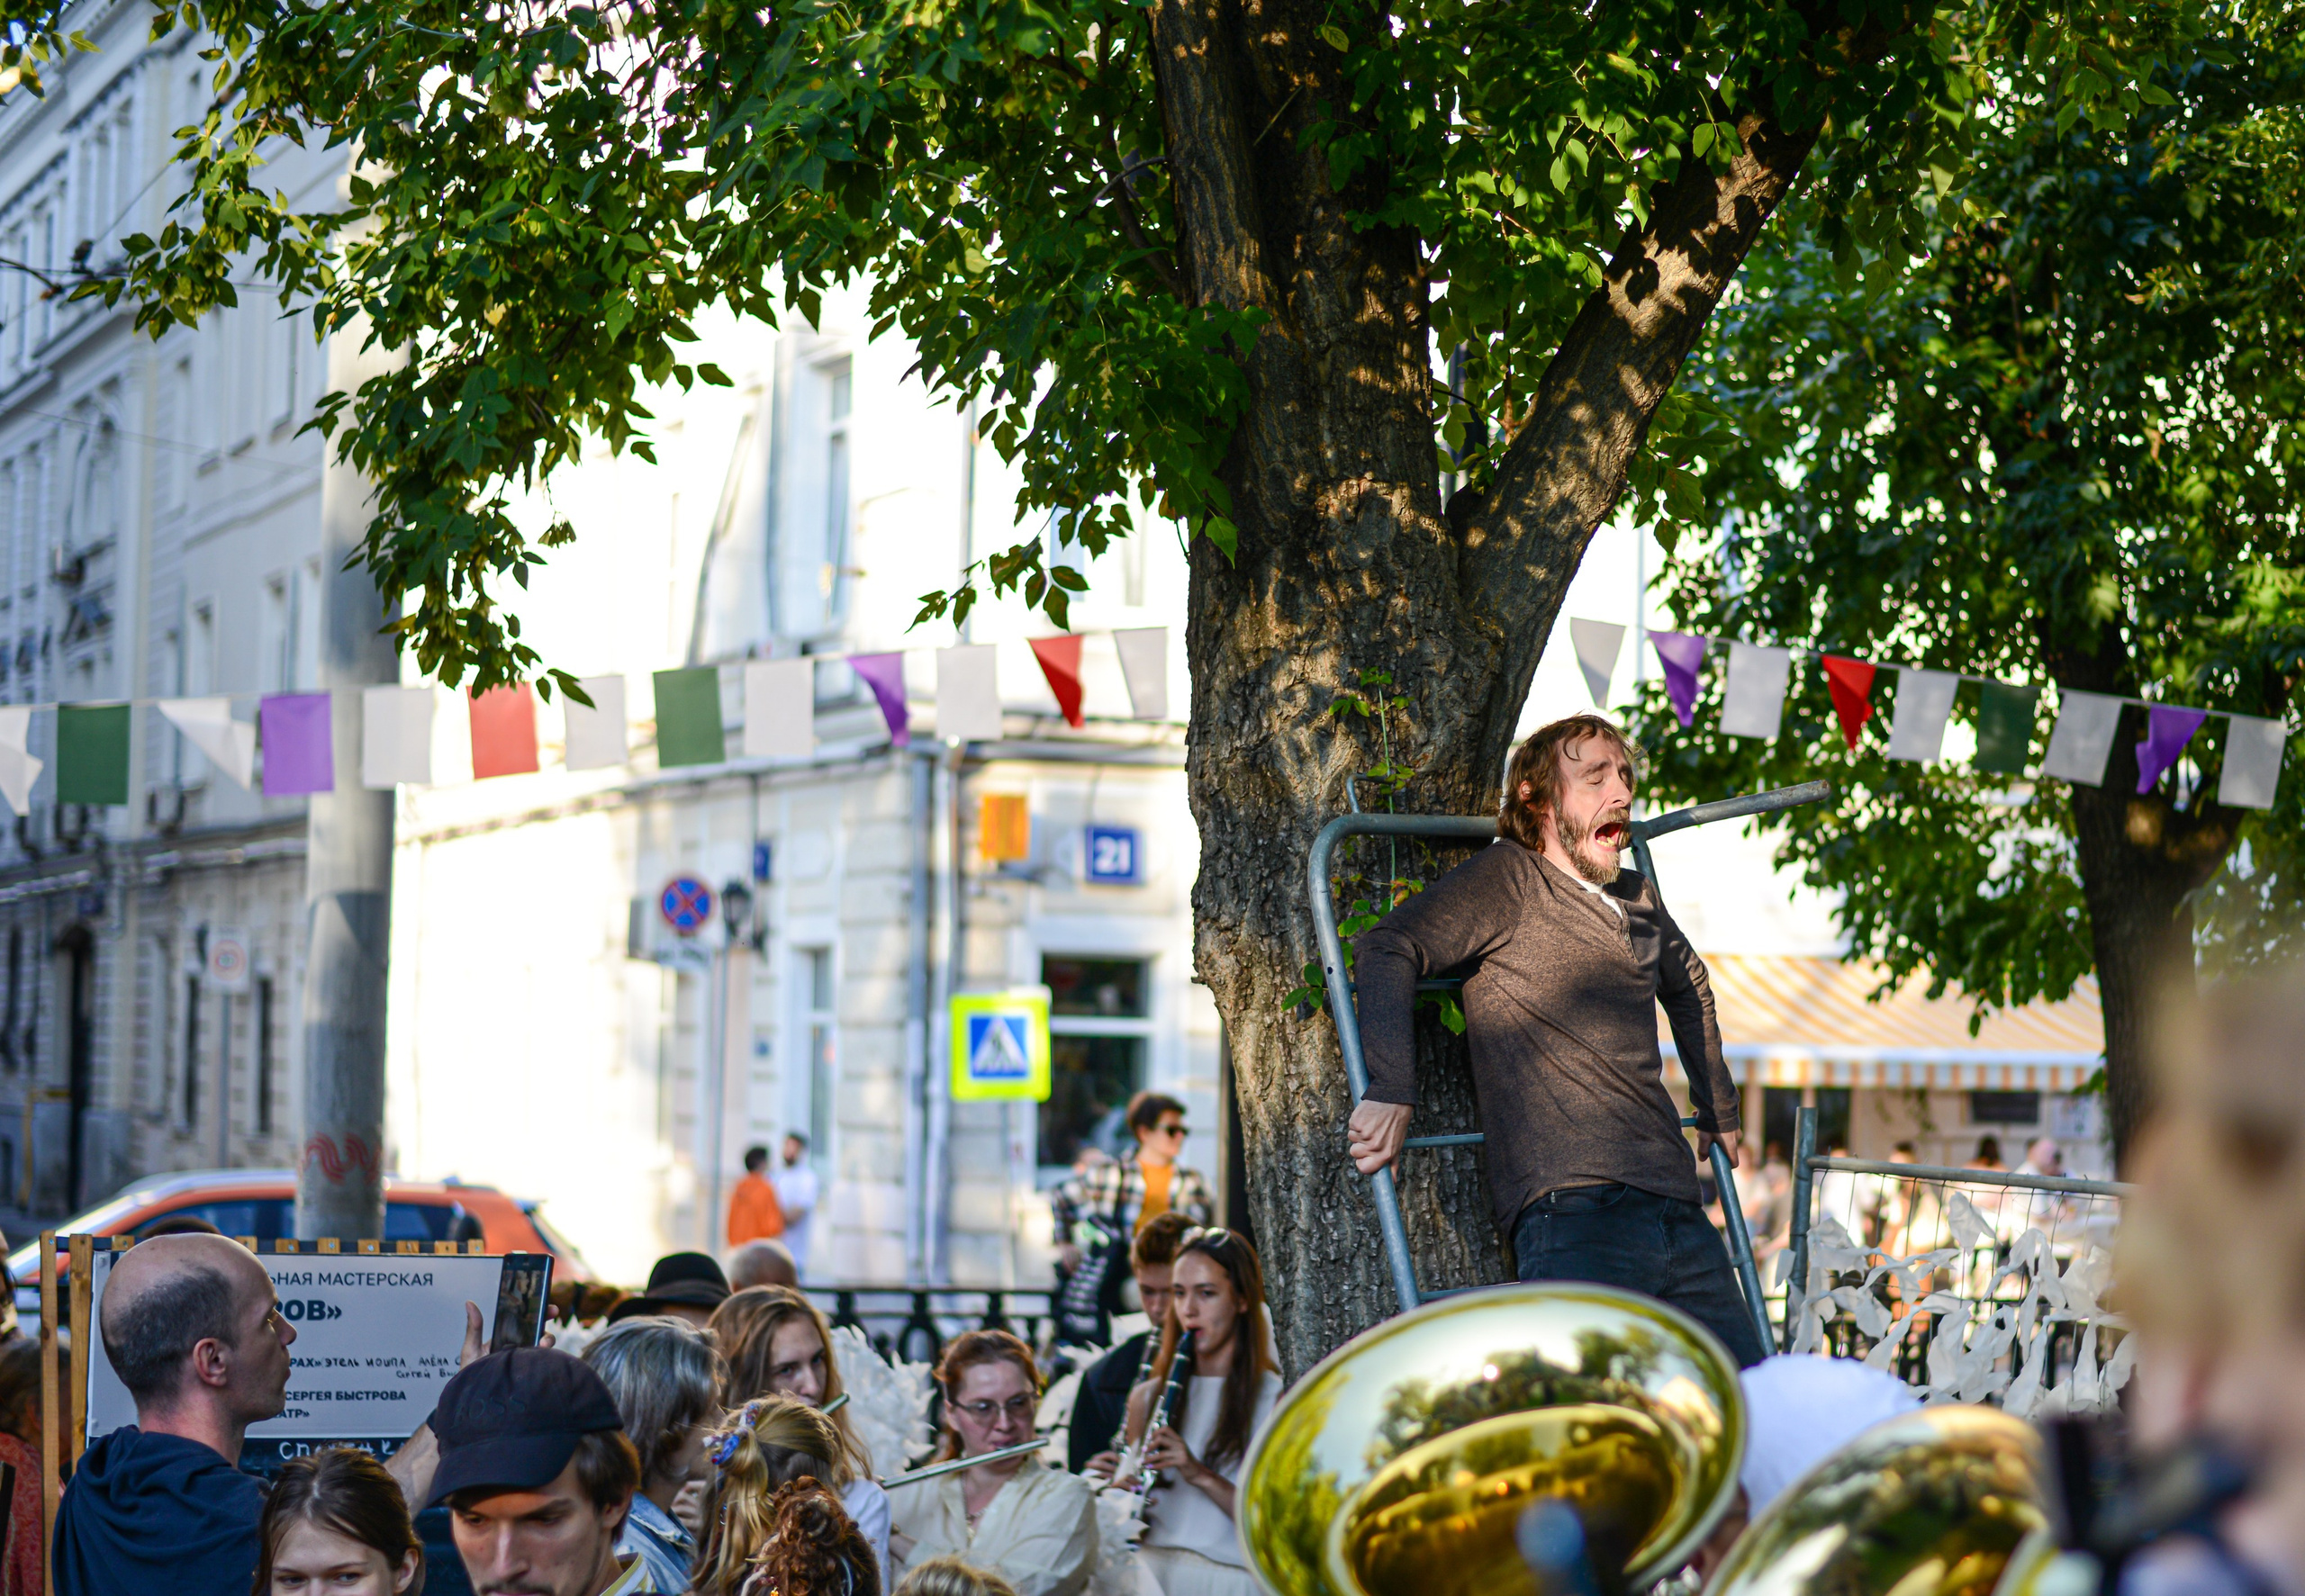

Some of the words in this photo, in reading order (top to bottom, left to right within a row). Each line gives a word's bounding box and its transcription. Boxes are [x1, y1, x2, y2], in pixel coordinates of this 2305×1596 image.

[1095, 836, 1131, 873] 21
[318, 1272, 434, 1286] МАСТЕРСКАЯ
[285, 1391, 332, 1401] СЕРГЕЯ
[336, 1391, 406, 1401] БЫСТРОВА
[274, 1408, 310, 1419] АТР»
